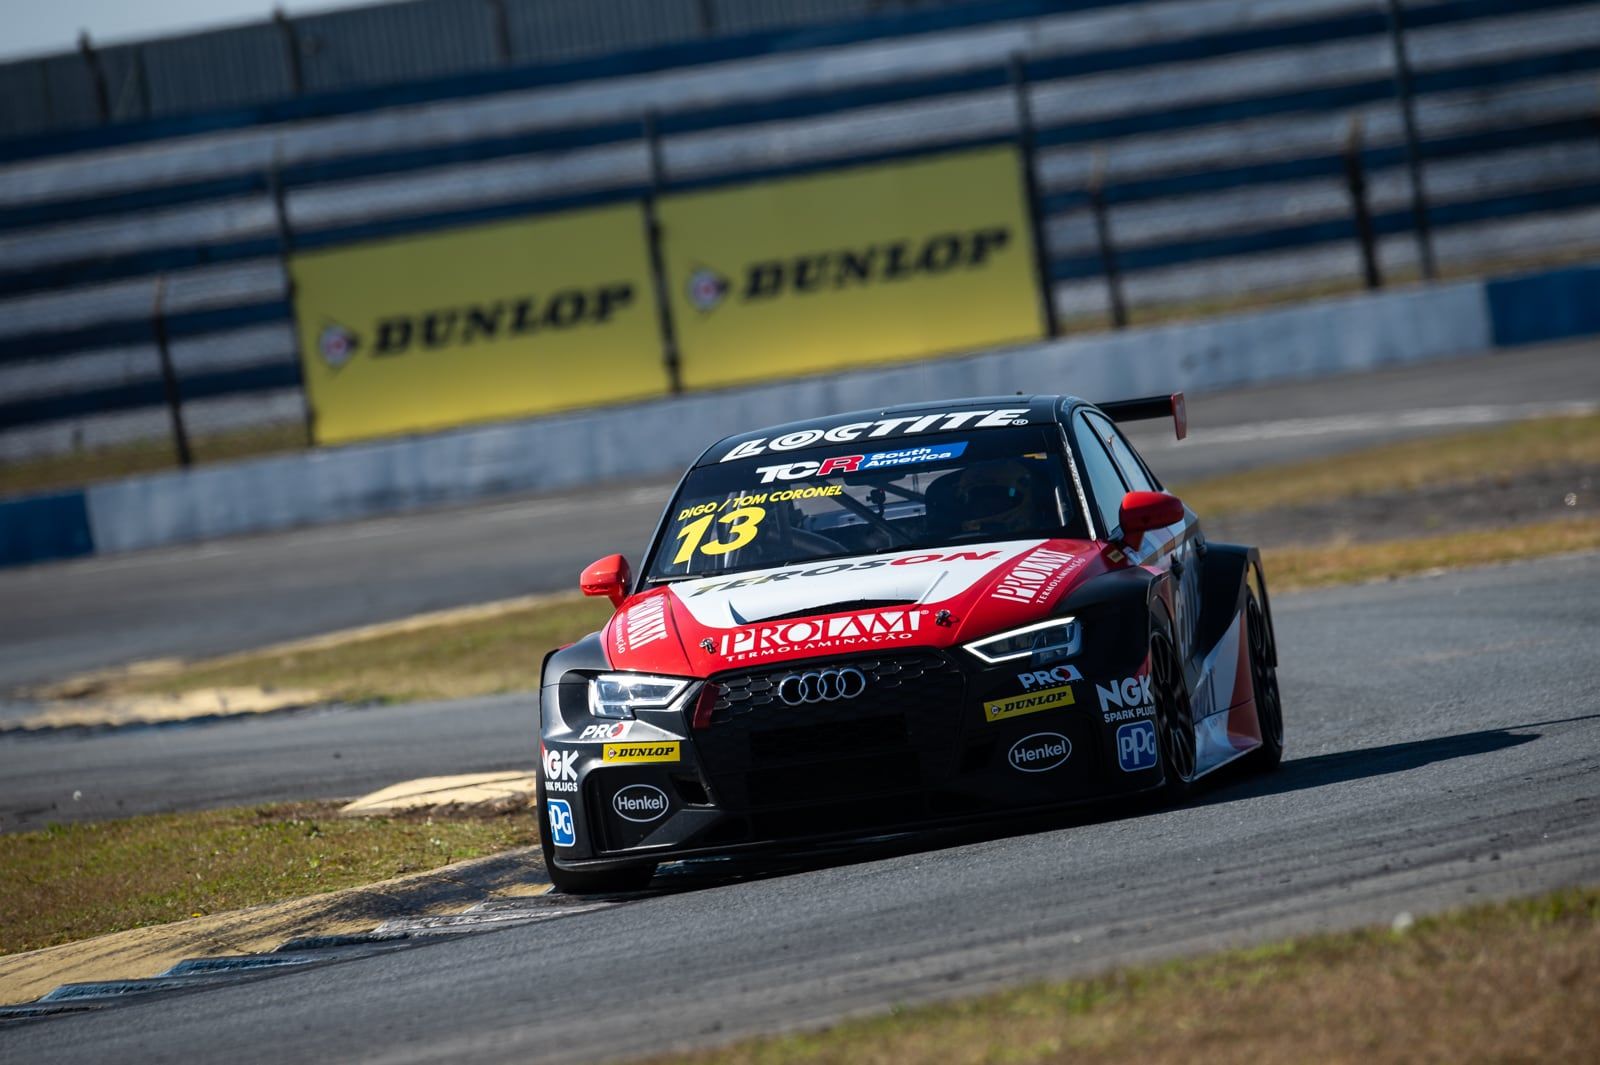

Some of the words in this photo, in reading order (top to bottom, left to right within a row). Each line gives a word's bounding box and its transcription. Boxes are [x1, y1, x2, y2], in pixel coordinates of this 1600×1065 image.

[740, 226, 1010, 303] DUNLOP
[370, 282, 637, 358] DUNLOP
[864, 452, 952, 468] America
[870, 447, 932, 460] South
[755, 454, 865, 484] TCR
[677, 501, 718, 521] DIGO
[732, 491, 767, 508] TOM
[769, 485, 843, 503] CORONEL
[673, 506, 767, 565] 13
[689, 550, 1004, 598] TEROSON
[725, 632, 913, 663] TERMOLAMINAÇÃO
[1004, 691, 1067, 712] DUNLOP
[1095, 674, 1155, 712] NGK
[1104, 709, 1135, 723] SPARK
[618, 746, 675, 758] DUNLOP
[1014, 740, 1067, 763] Henkel
[1120, 727, 1155, 765] PPG
[555, 781, 579, 792] PLUGS
[617, 794, 664, 811] Henkel
